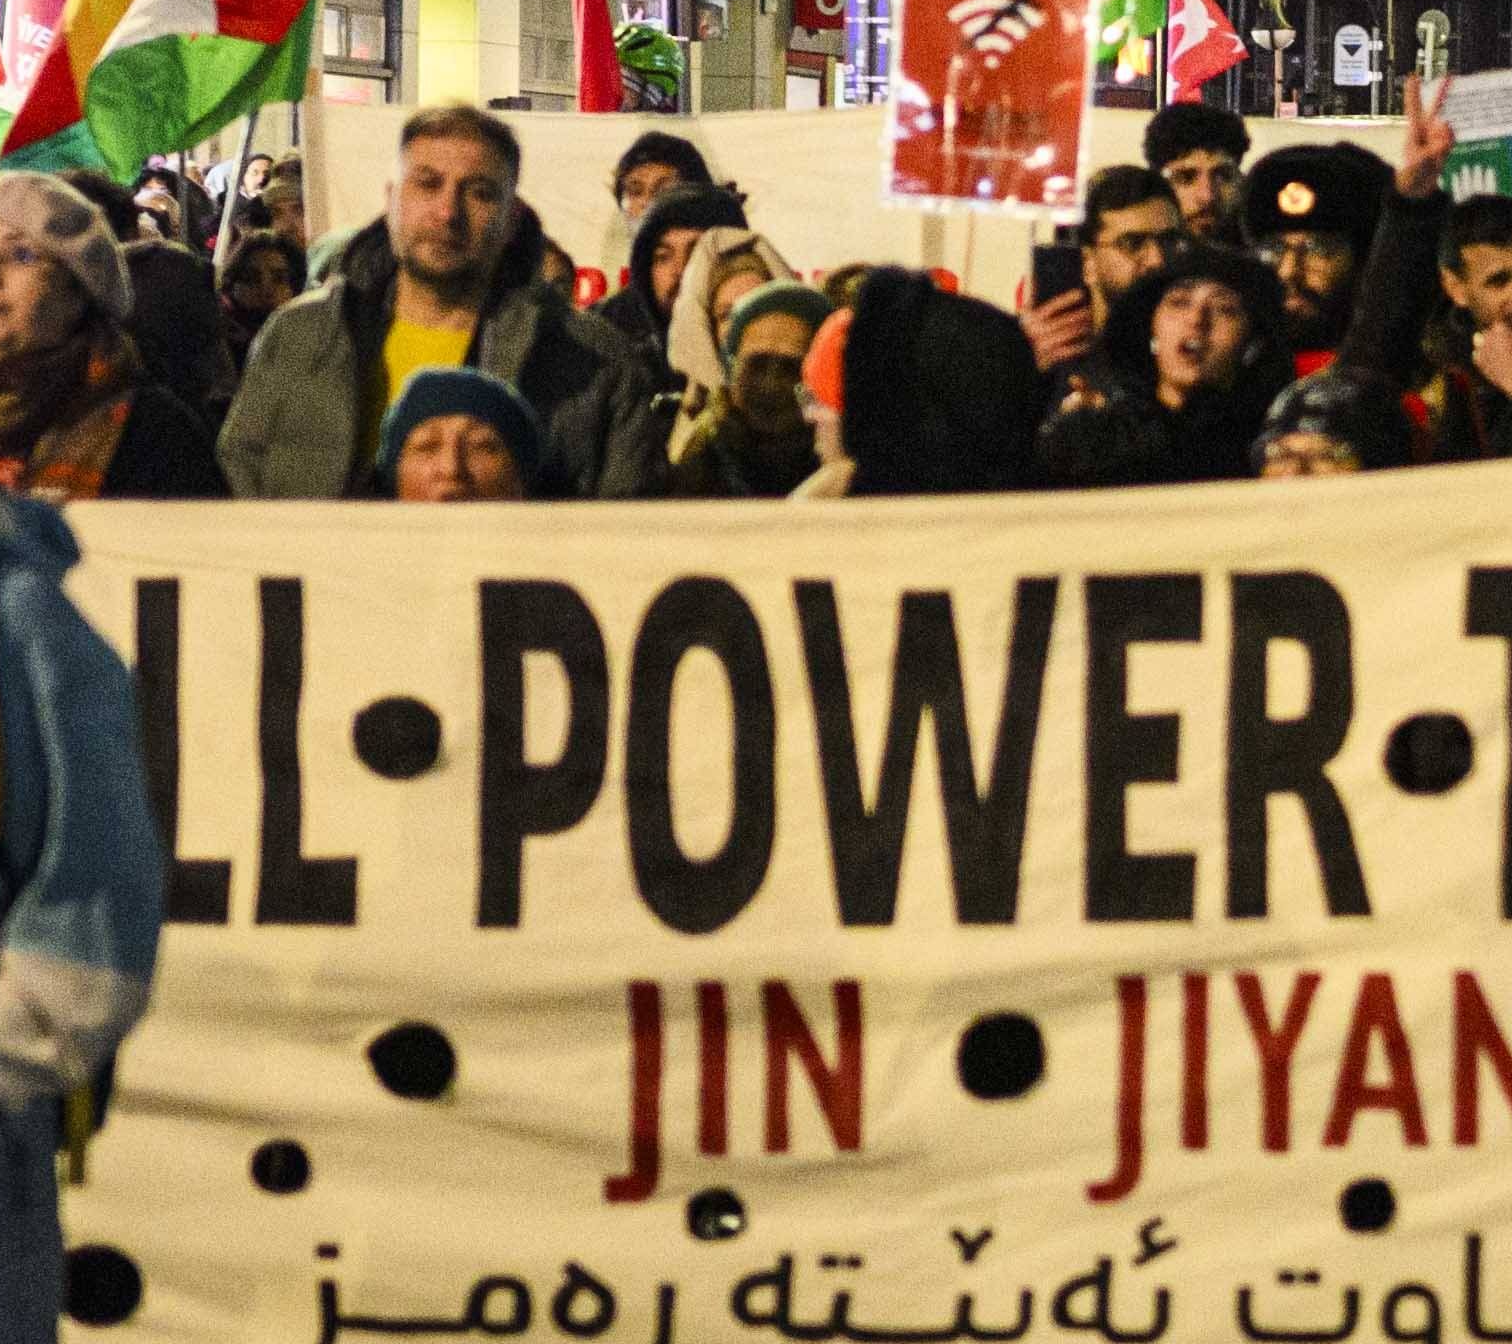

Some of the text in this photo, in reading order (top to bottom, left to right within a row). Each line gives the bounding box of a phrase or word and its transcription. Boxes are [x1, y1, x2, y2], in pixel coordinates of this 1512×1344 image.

[132, 576, 358, 924] LL
[475, 569, 1372, 937] POWER
[604, 978, 865, 1203] JIN
